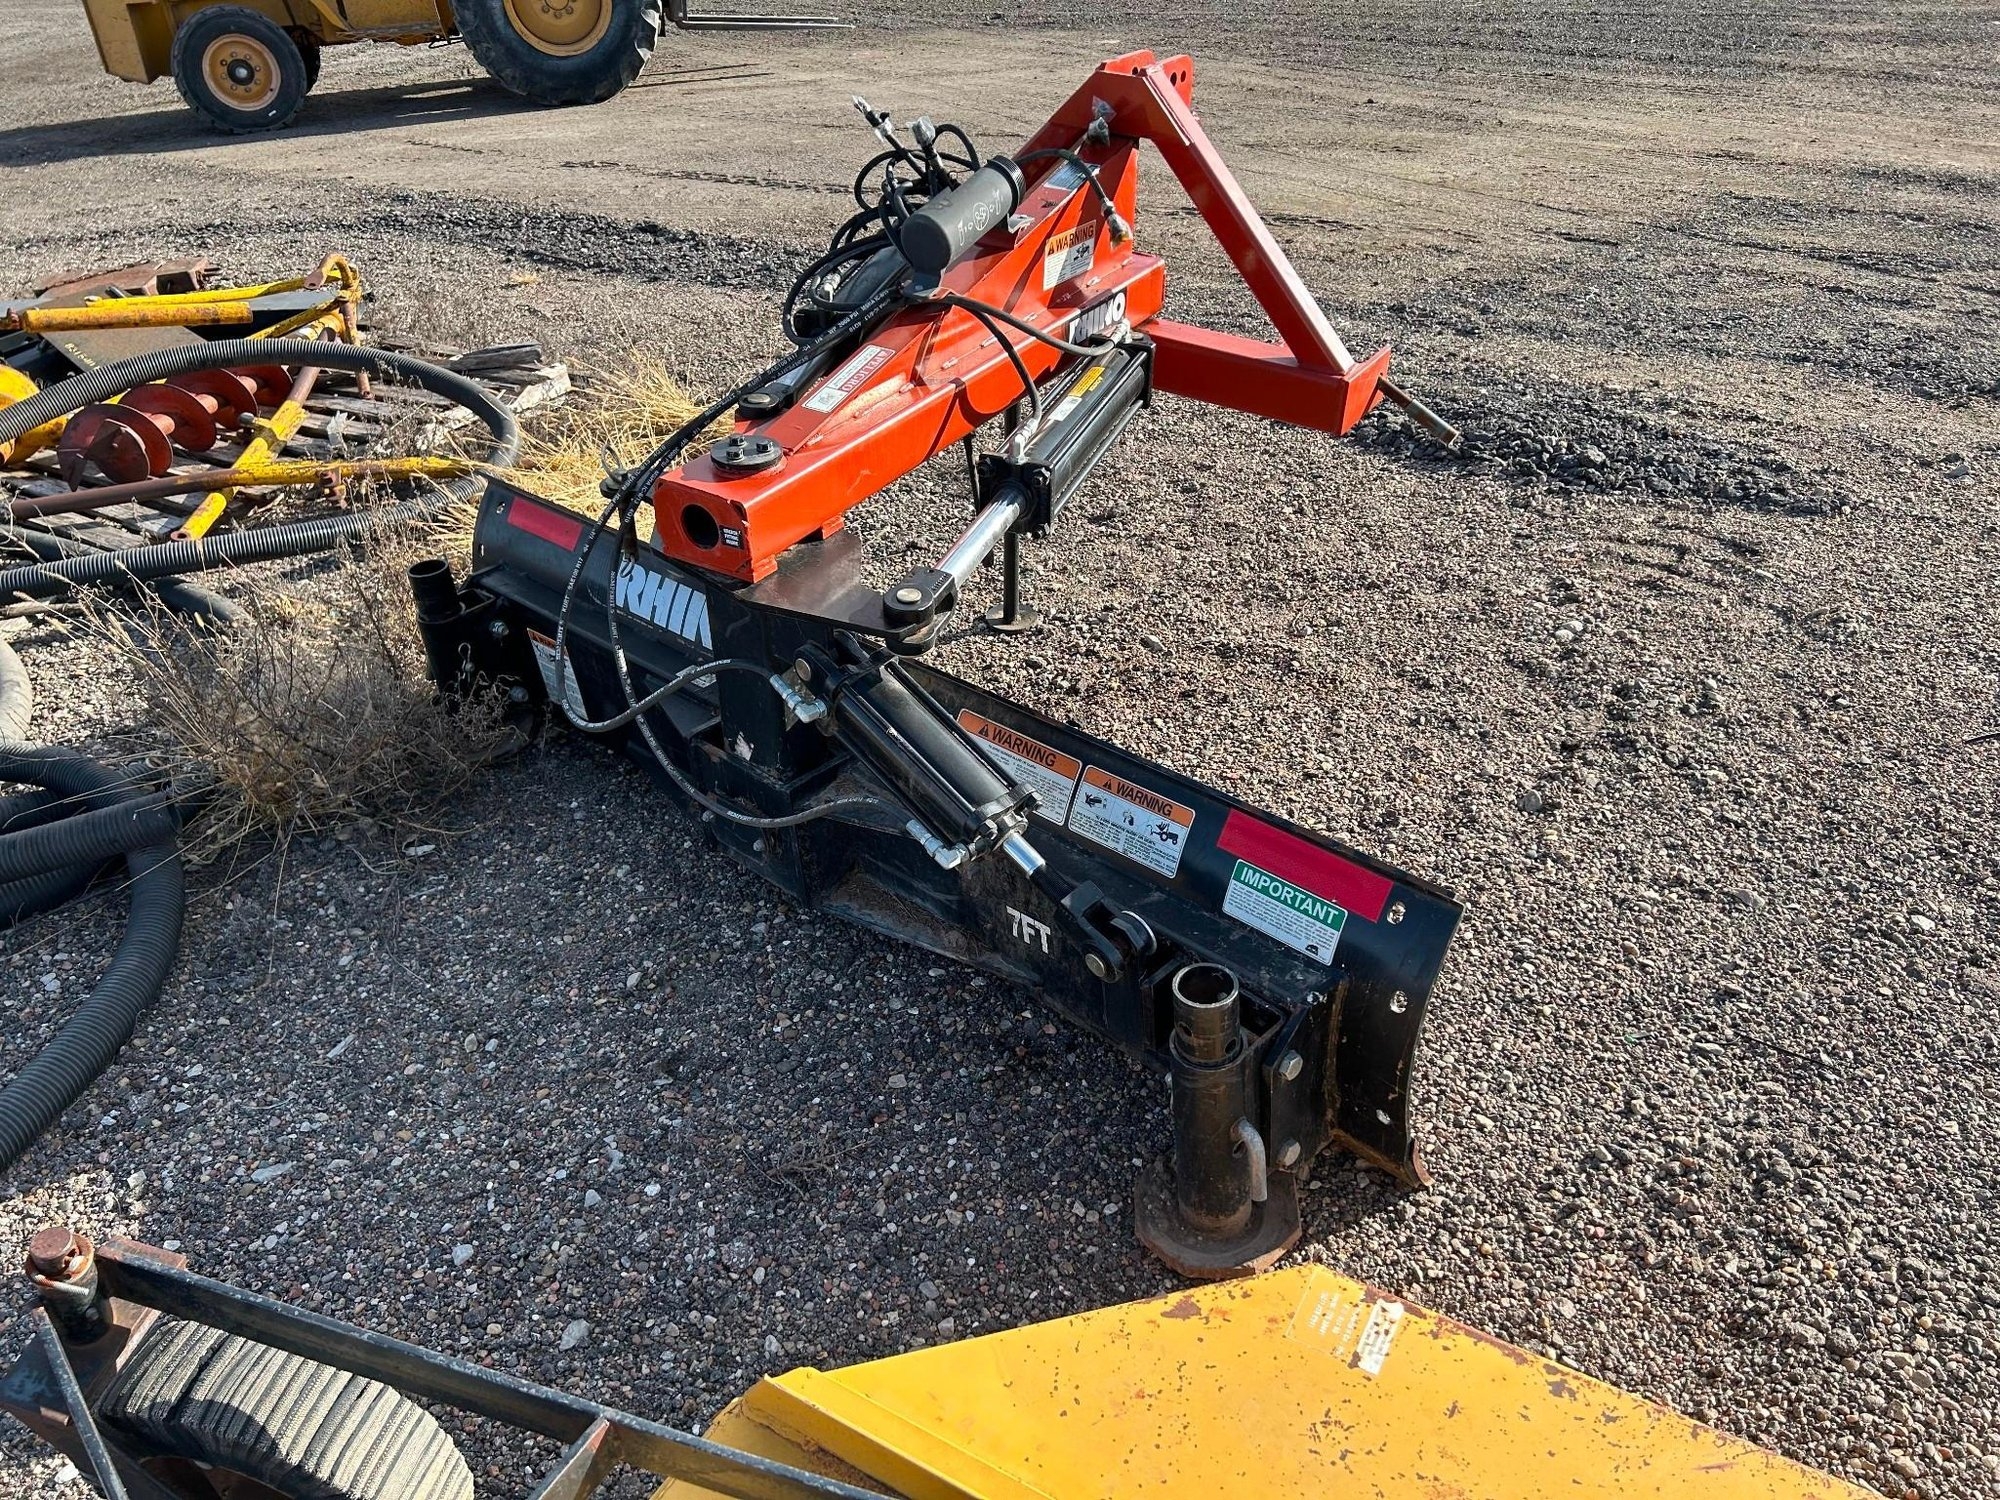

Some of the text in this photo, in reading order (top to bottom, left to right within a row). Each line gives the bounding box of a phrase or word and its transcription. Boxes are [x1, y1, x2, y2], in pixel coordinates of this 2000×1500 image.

[1054, 224, 1093, 251] WARNING
[1068, 292, 1124, 344] RHINO
[841, 355, 884, 390] PELIGRO
[992, 727, 1056, 767] WARNING
[1117, 782, 1172, 816] WARNING
[1240, 866, 1338, 924] IMPORTANT
[1006, 905, 1051, 954] 7FT
